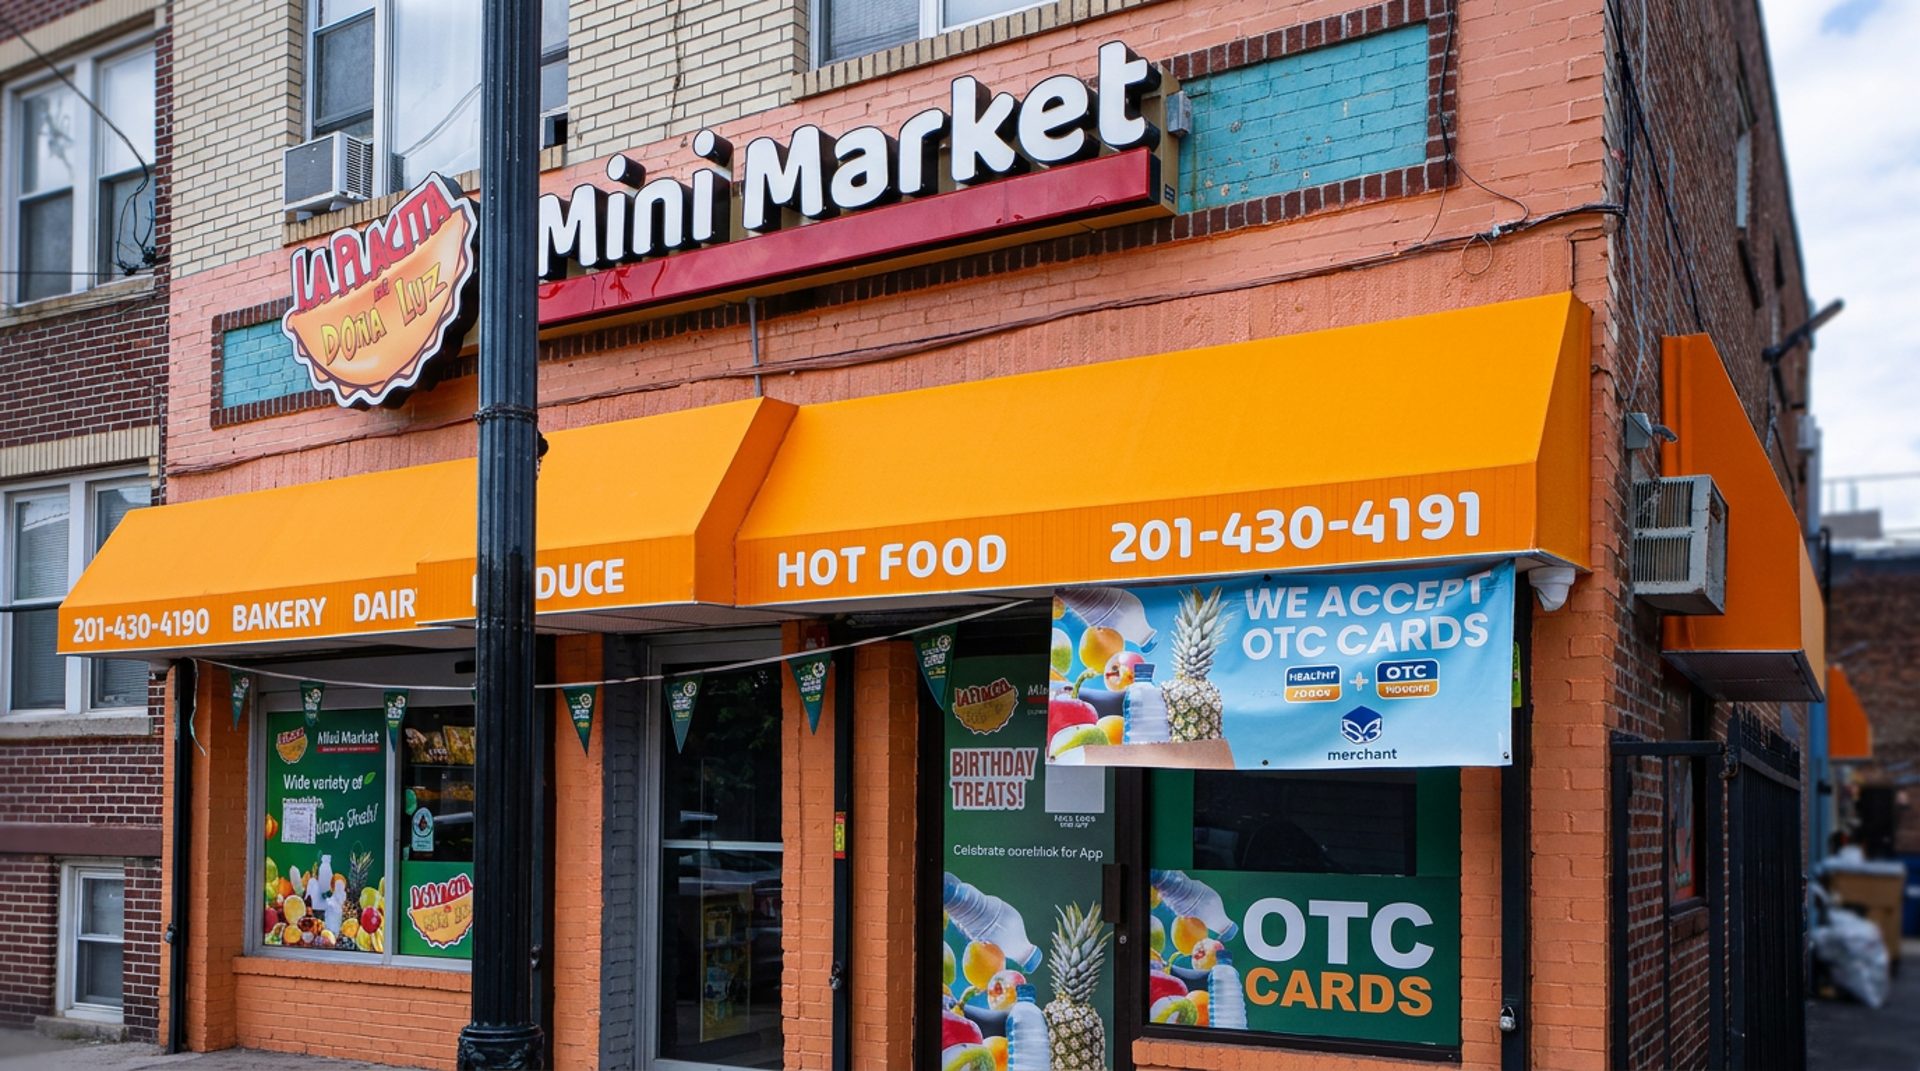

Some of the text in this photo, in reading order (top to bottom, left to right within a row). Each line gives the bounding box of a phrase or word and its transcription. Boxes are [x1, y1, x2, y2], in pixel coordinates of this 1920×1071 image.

[538, 39, 1149, 278] Mini Market
[1109, 491, 1481, 563] 201-430-4191
[777, 534, 1008, 588] HOT FOOD
[72, 588, 418, 644] 201-430-4190 BAKERY DAIR
[1244, 570, 1492, 620] WE ACCEPT
[1242, 612, 1489, 660] OTC CARDS
[1386, 665, 1427, 679] OTC
[952, 750, 1036, 777] BIRTHDAY
[1327, 748, 1398, 761] merchant
[952, 781, 1024, 807] TREATS!
[1061, 846, 1078, 858] for
[1079, 847, 1104, 863] App
[1242, 897, 1435, 970] OTC
[1244, 967, 1434, 1017] CARDS
